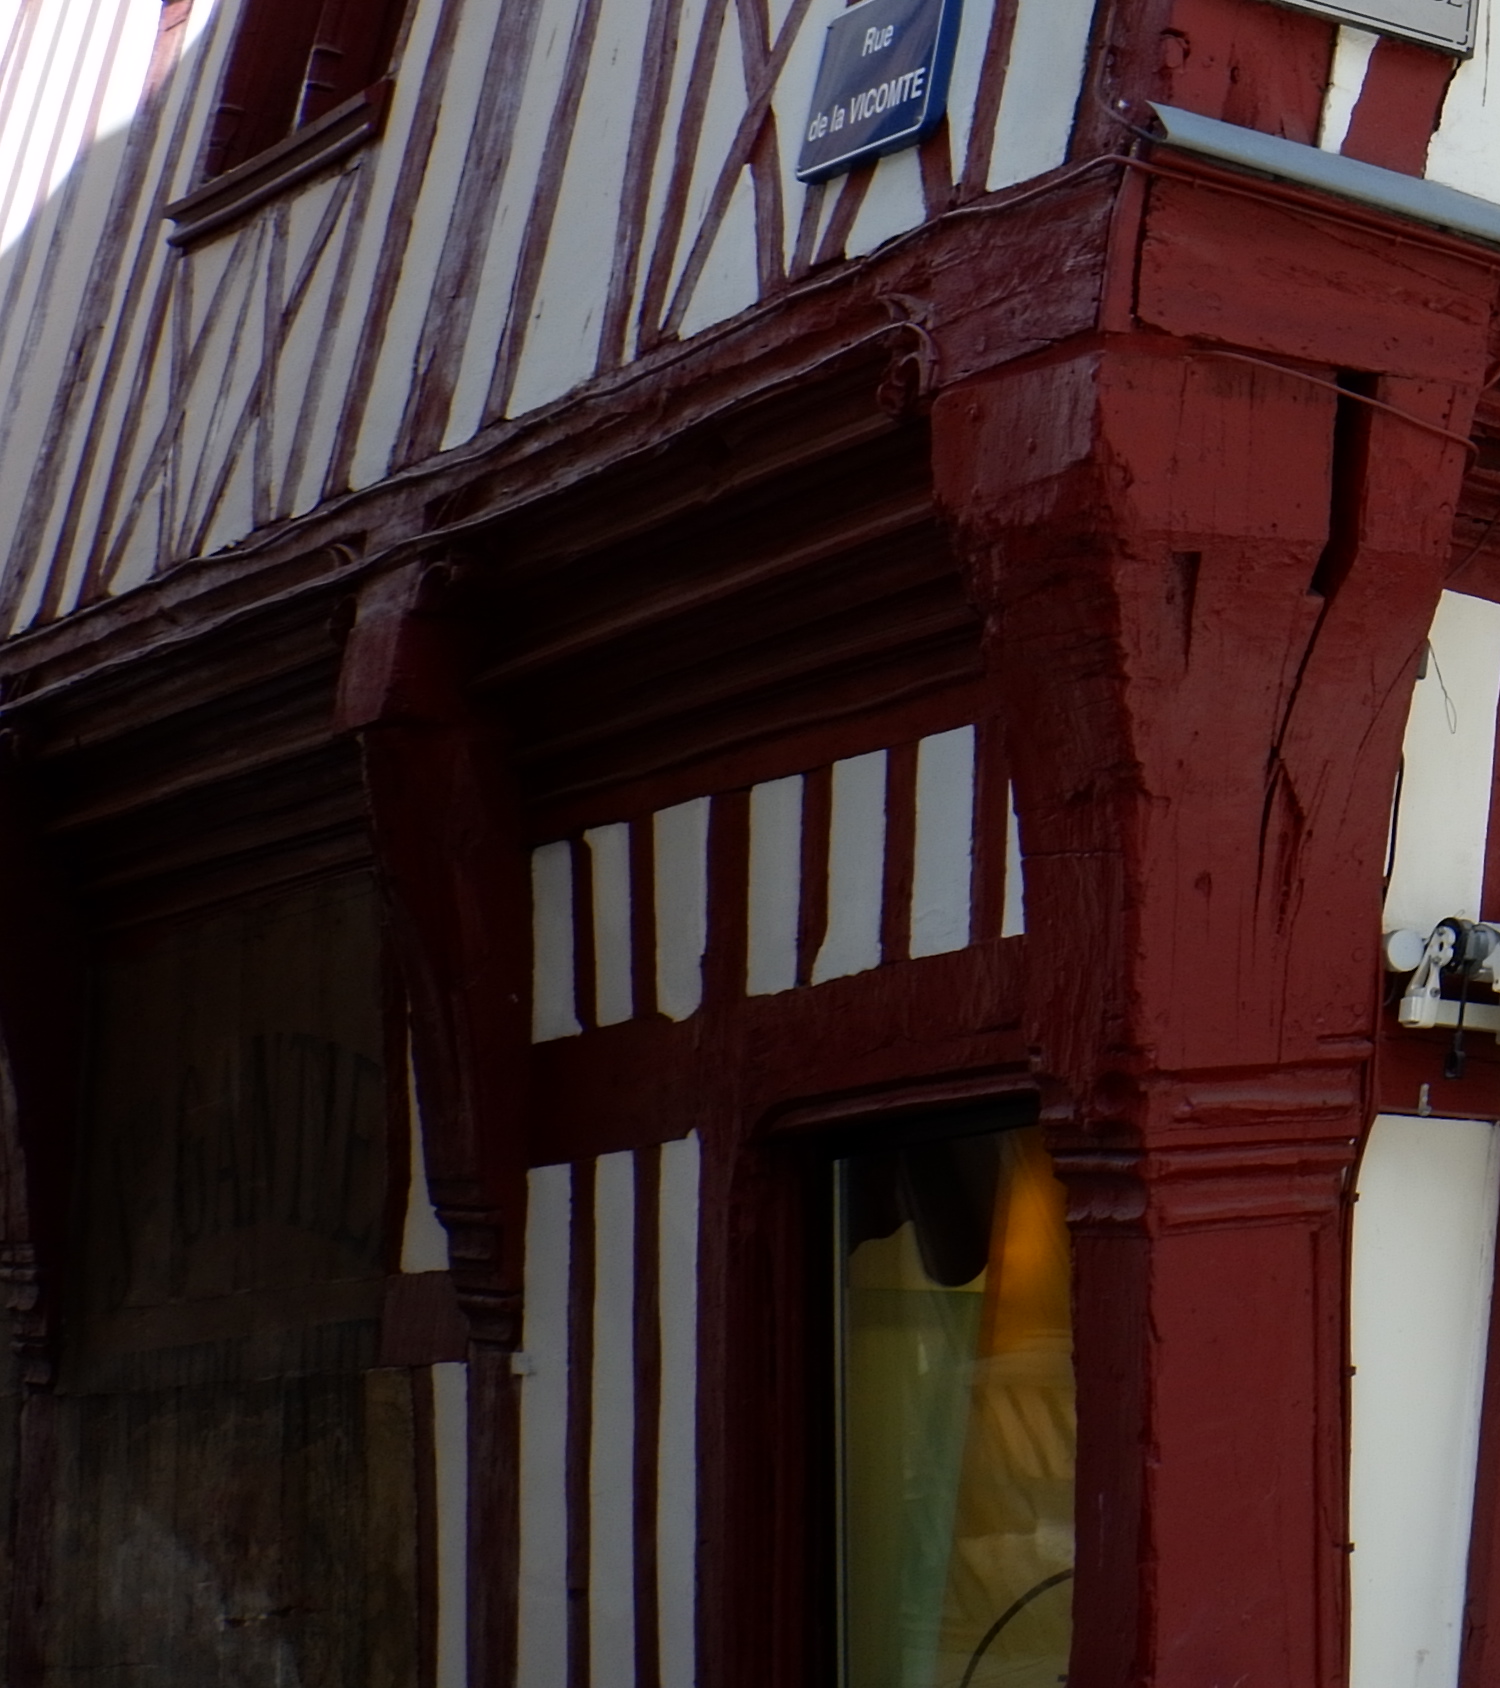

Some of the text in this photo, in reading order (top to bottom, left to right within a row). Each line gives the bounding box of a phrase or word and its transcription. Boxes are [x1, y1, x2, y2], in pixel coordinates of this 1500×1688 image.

[862, 24, 894, 57] Rue
[807, 113, 828, 142] de
[829, 104, 845, 134] la
